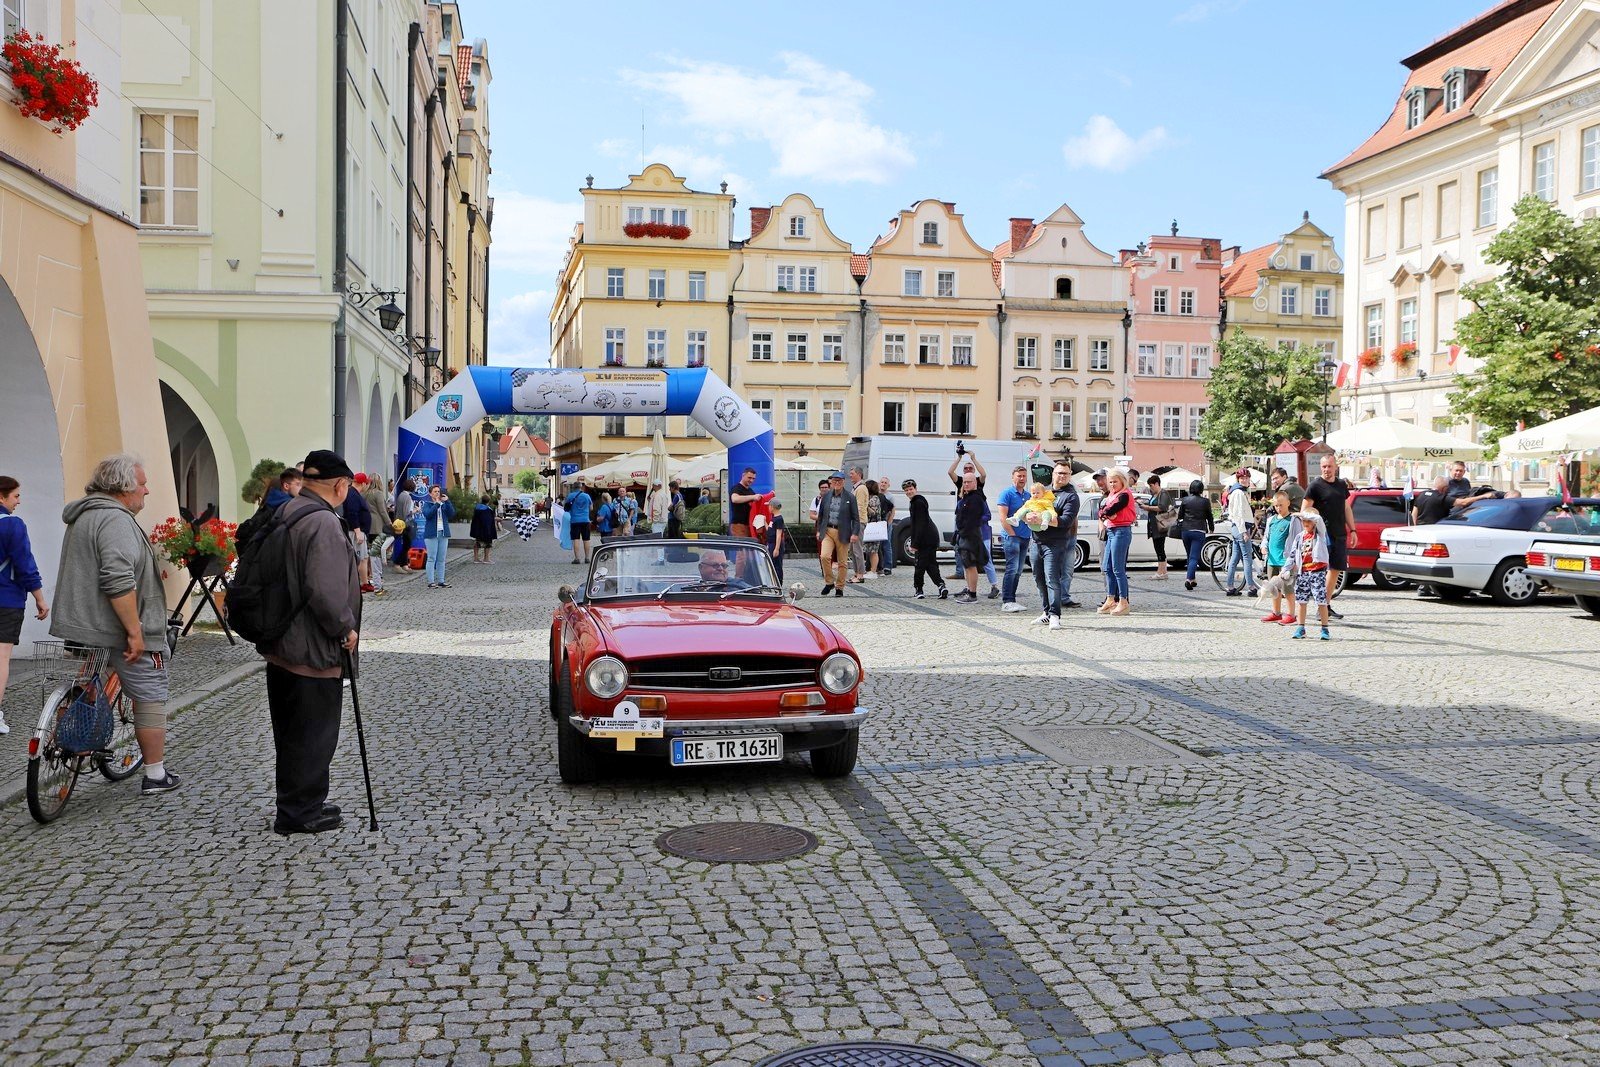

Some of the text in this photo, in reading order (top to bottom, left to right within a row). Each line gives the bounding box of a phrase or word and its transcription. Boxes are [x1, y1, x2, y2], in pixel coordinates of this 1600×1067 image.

[1518, 437, 1545, 451] Kozel
[1424, 447, 1454, 457] Kozel
[684, 739, 778, 760] RE TR 163H
